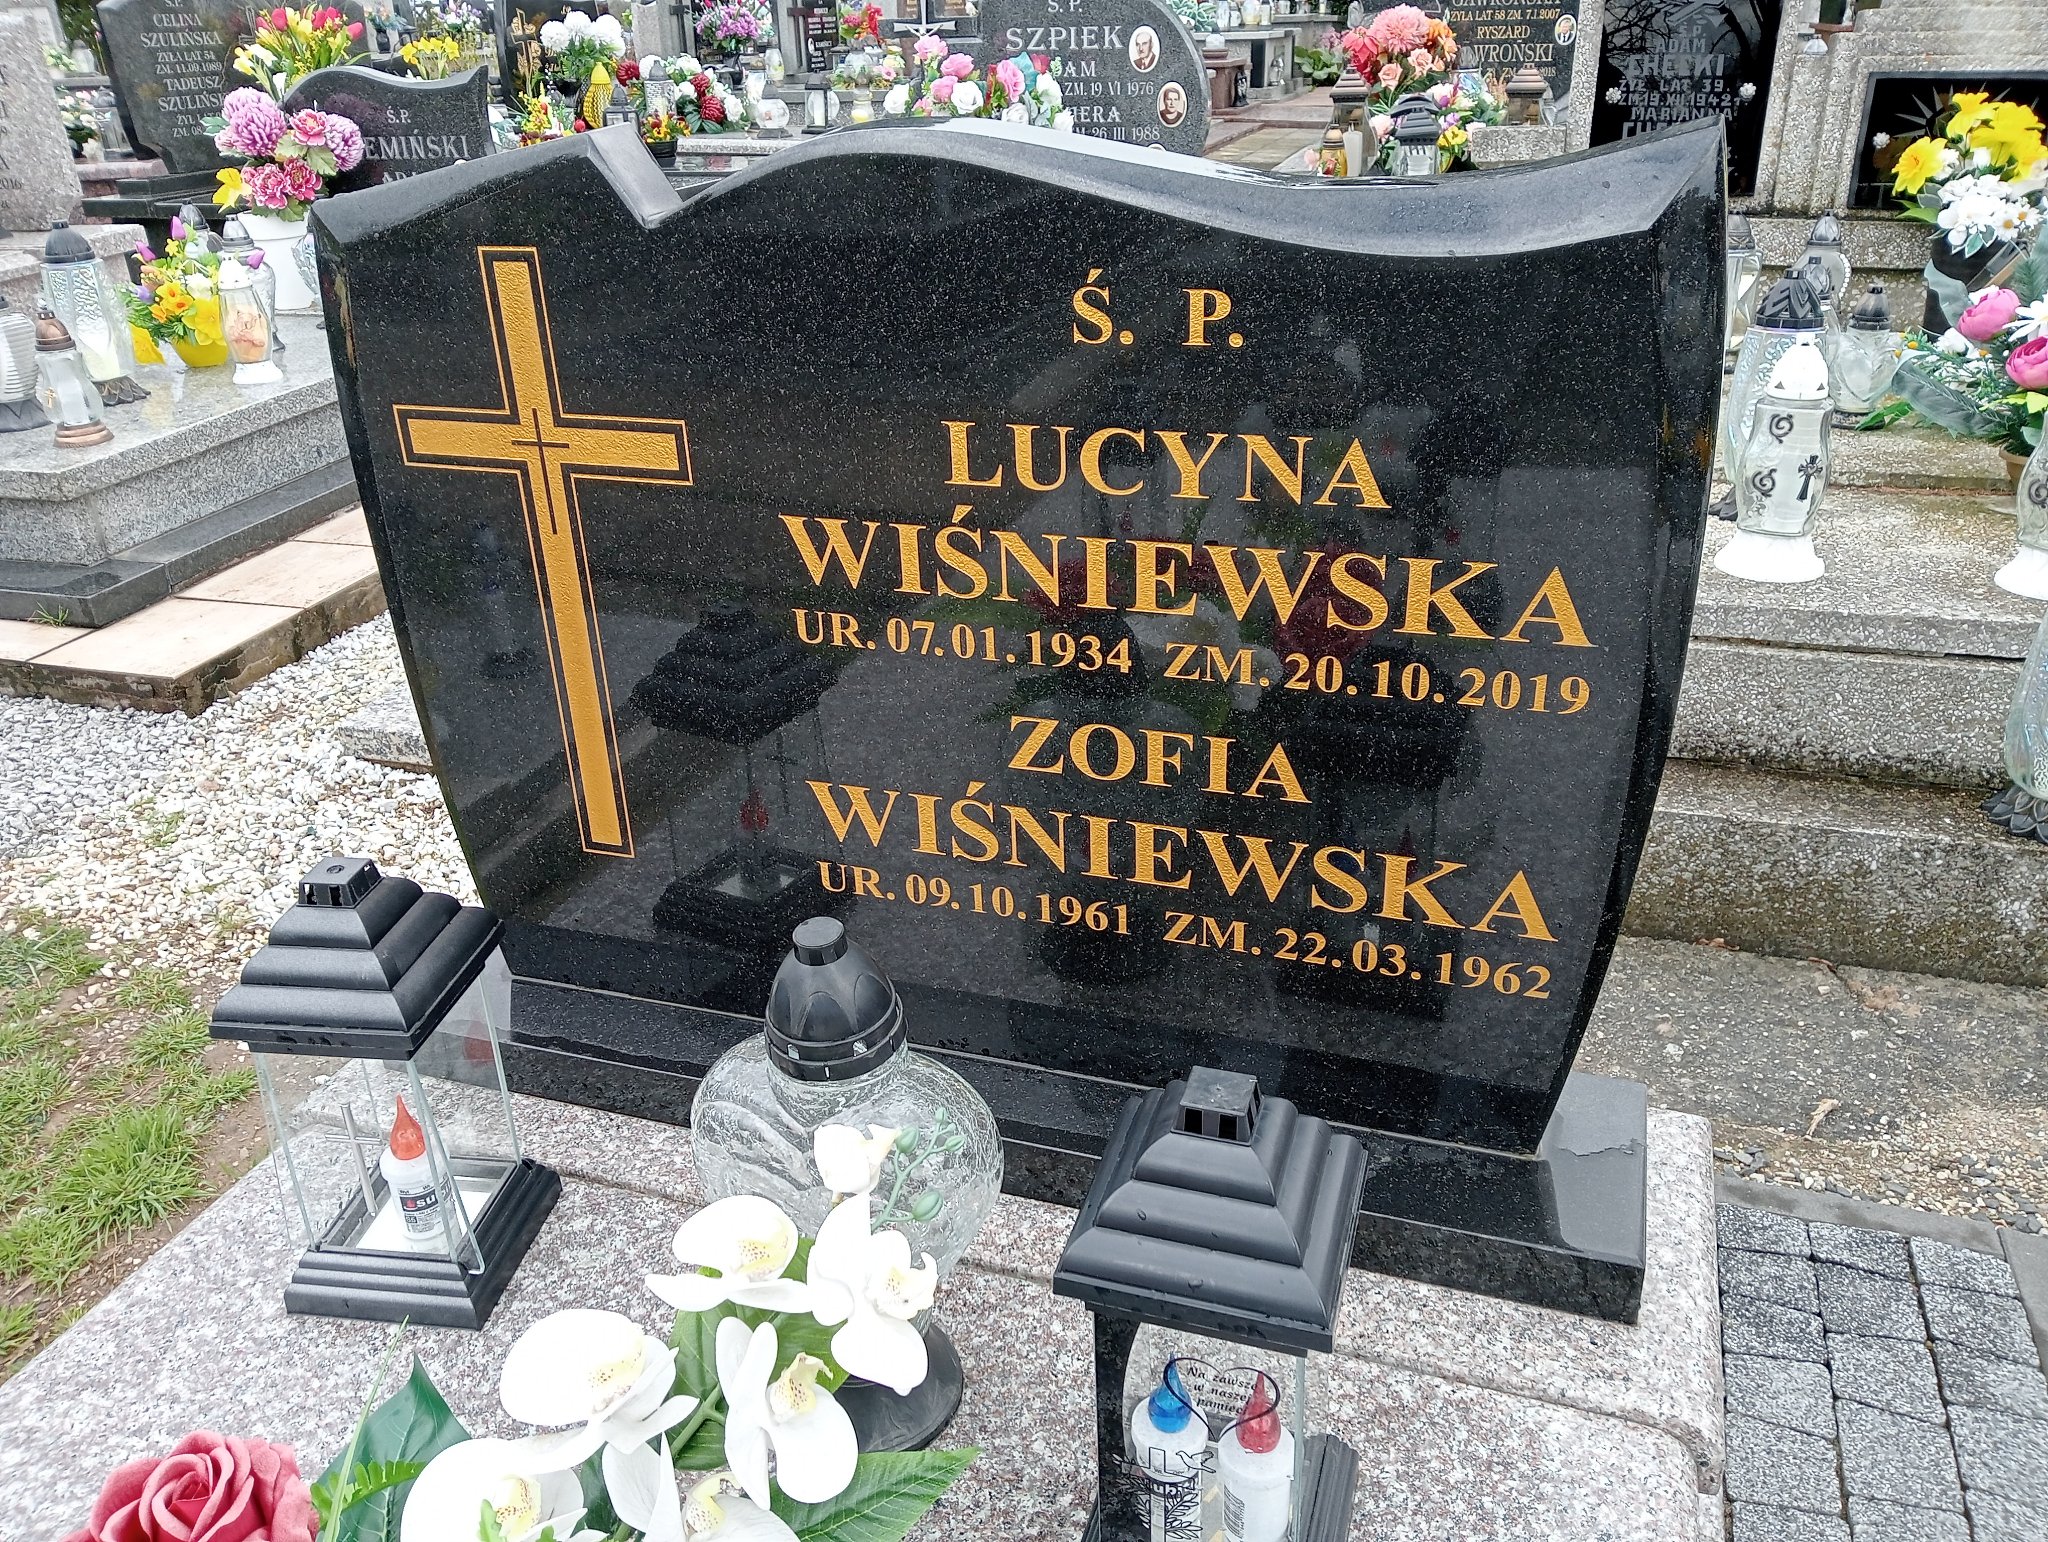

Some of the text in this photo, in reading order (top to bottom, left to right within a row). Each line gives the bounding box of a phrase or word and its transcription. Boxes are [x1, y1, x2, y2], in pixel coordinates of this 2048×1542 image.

[153, 13, 204, 27] CELINA
[1475, 10, 1494, 20] LAT
[140, 28, 224, 48] SZULIŃSKA
[1005, 26, 1125, 51] SZPIEK
[1477, 25, 1531, 39] RYSZARD
[185, 50, 202, 61] LAT
[1474, 39, 1556, 63] WROŃSKI
[1655, 38, 1706, 53] ADAM
[155, 64, 173, 75] ZM.
[1063, 60, 1097, 77] AM
[163, 75, 222, 91] TADEUSZ
[1064, 82, 1087, 96] ZM.
[1090, 82, 1103, 97] 19
[1127, 81, 1154, 96] 1976
[1131, 126, 1161, 142] 1988
[364, 129, 472, 161] EMIŃSKI
[1071, 268, 1246, 348] Ś. P.
[944, 420, 1392, 509] LUCYNA
[780, 504, 1594, 649] WIŚNIEWSKA
[791, 608, 1592, 715] UR. 07.01.1934 ZM. 20.10.2019
[1008, 715, 1309, 803] ZOFIA
[807, 779, 1558, 942] WIŚNIEWSKA
[816, 860, 1552, 999] UR. 09.10.1961 ZM. 22.03.1962
